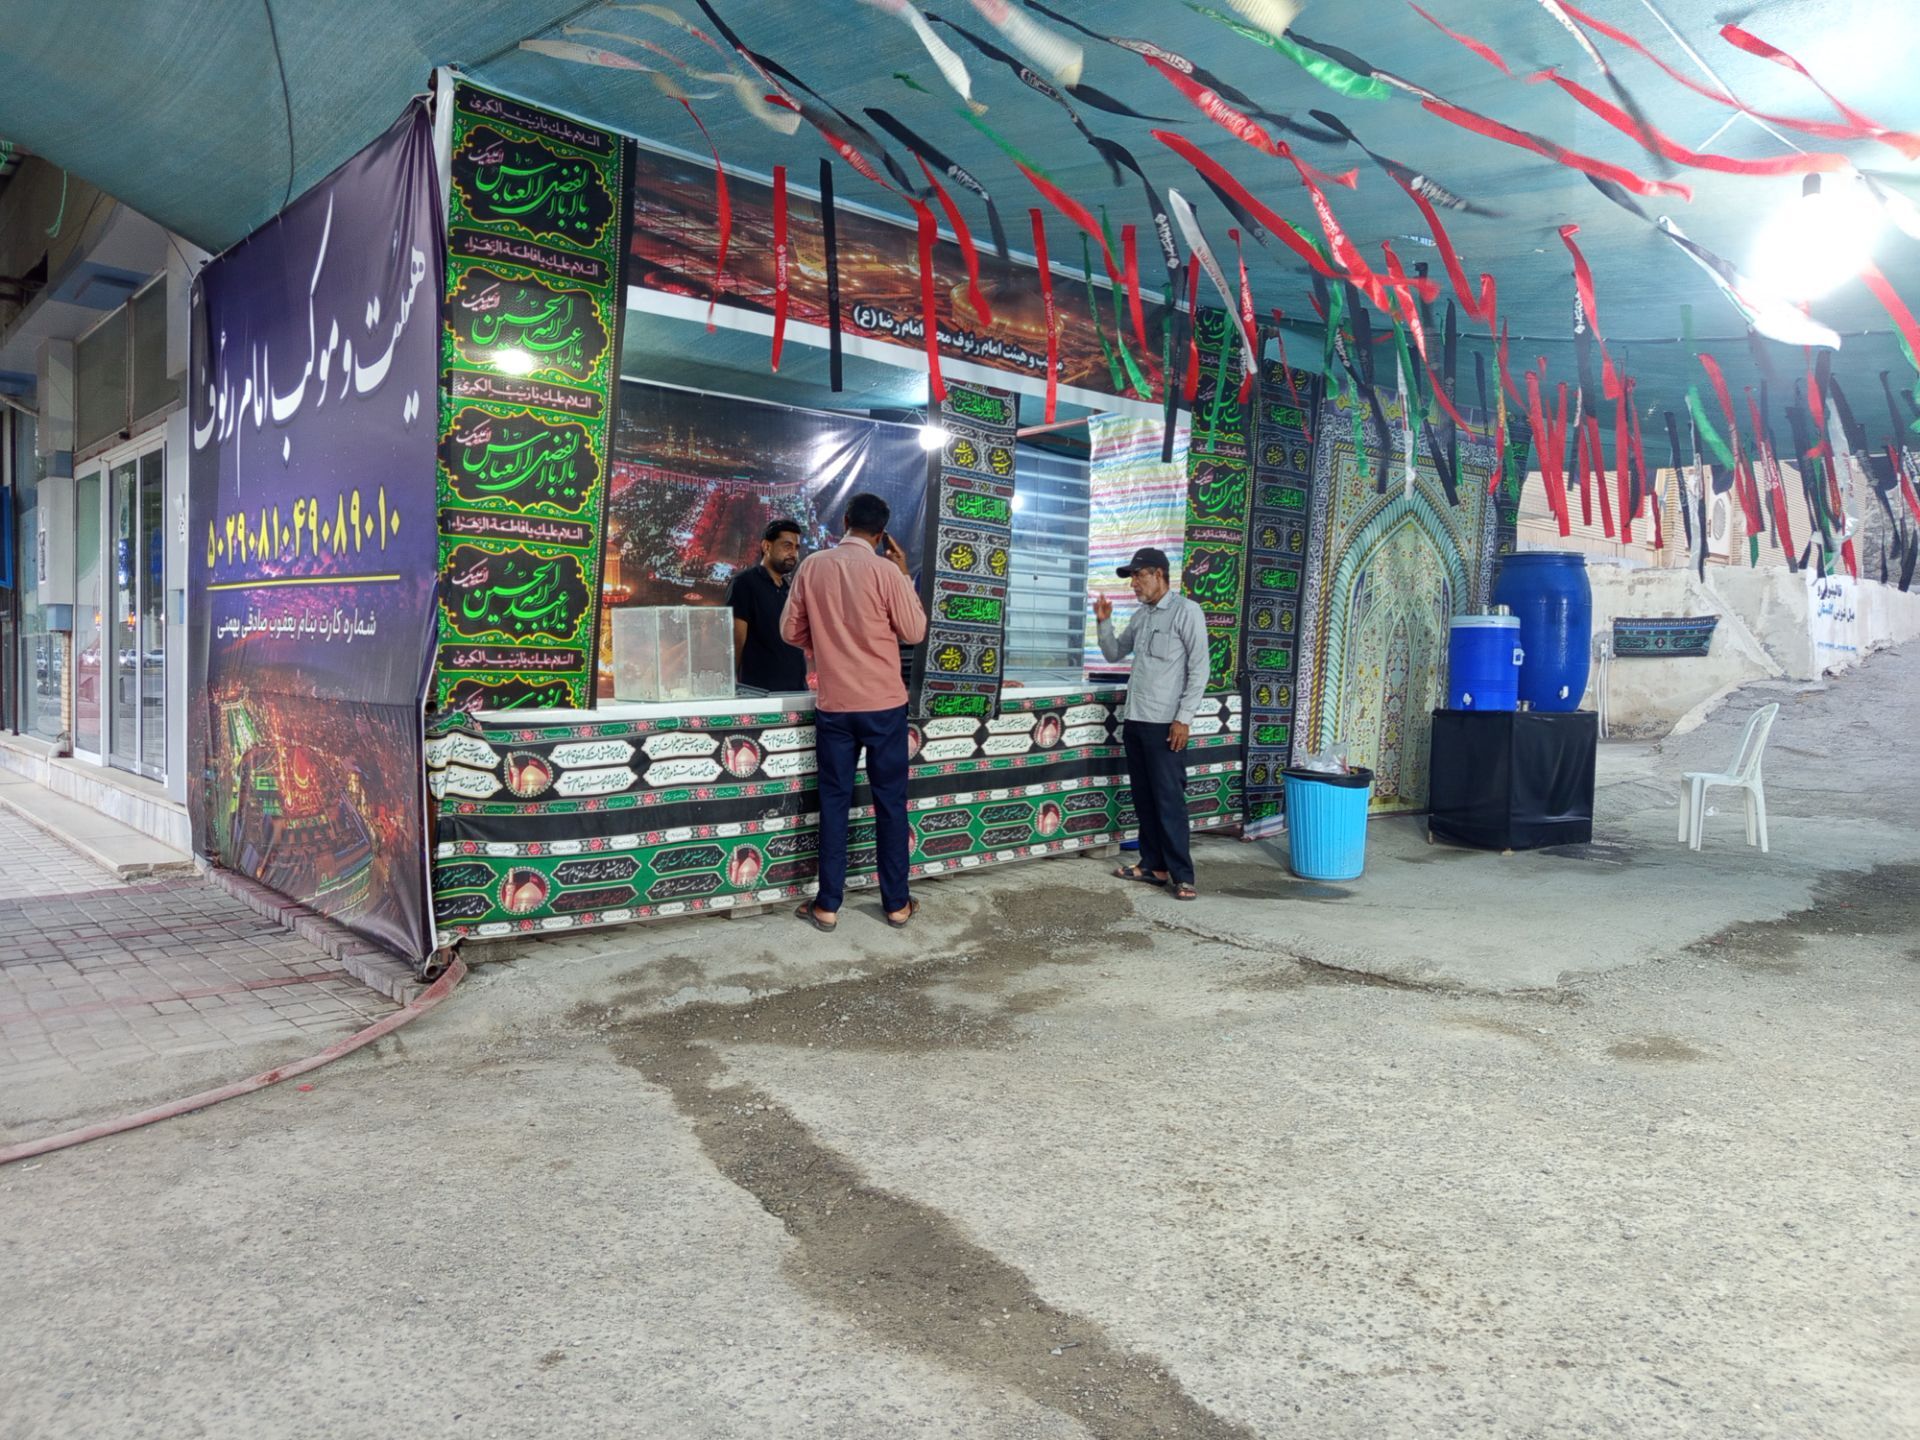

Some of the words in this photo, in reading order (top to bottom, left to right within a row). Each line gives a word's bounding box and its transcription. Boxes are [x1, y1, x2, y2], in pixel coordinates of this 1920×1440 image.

[271, 191, 340, 461] موکب
[853, 305, 877, 329] (ع)
[878, 310, 902, 336] رضا
[900, 318, 924, 338] امام
[952, 331, 979, 355] رئوف
[980, 339, 1003, 357] امام
[340, 338, 352, 400] و
[1028, 355, 1036, 369] و
[193, 330, 235, 450] رئوف
[236, 341, 269, 498] امام
[217, 616, 241, 639] بهمنی
[241, 607, 269, 638] صادقی
[269, 610, 297, 639] یعقوب
[296, 608, 318, 640] بنام
[319, 607, 343, 642] کارت
[343, 609, 377, 643] شماره
